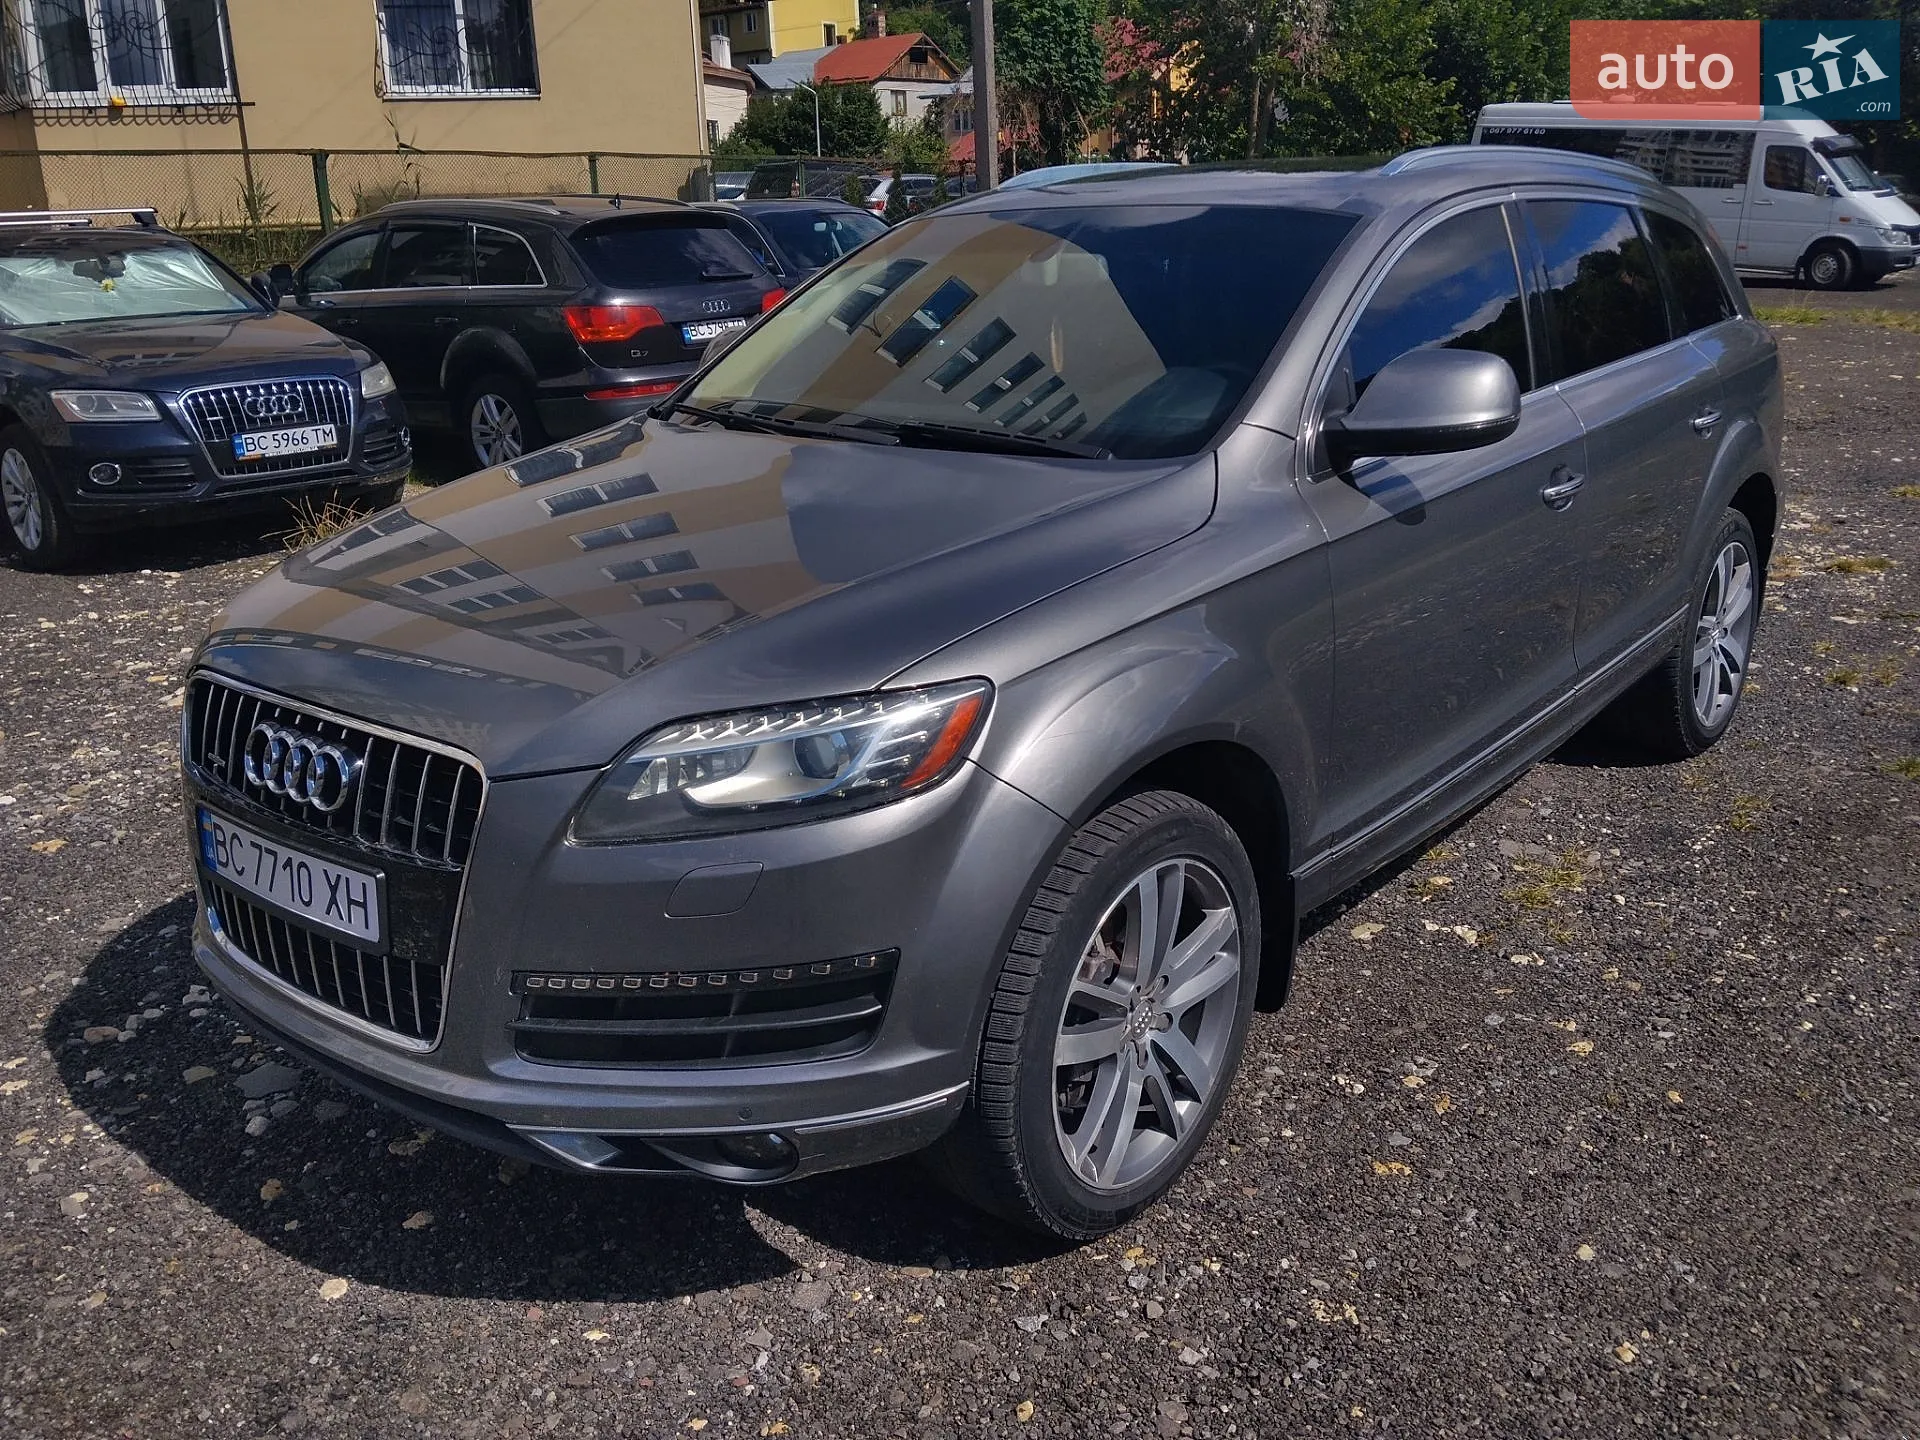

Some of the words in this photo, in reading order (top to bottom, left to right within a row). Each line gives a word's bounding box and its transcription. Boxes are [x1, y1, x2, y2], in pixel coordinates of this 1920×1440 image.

[689, 324, 706, 337] BC
[631, 349, 648, 357] Q7
[244, 436, 269, 452] BC
[272, 431, 309, 449] 5966
[311, 427, 335, 444] TM
[212, 821, 246, 876] BC
[250, 840, 313, 908] 7710
[322, 868, 369, 930] XH
